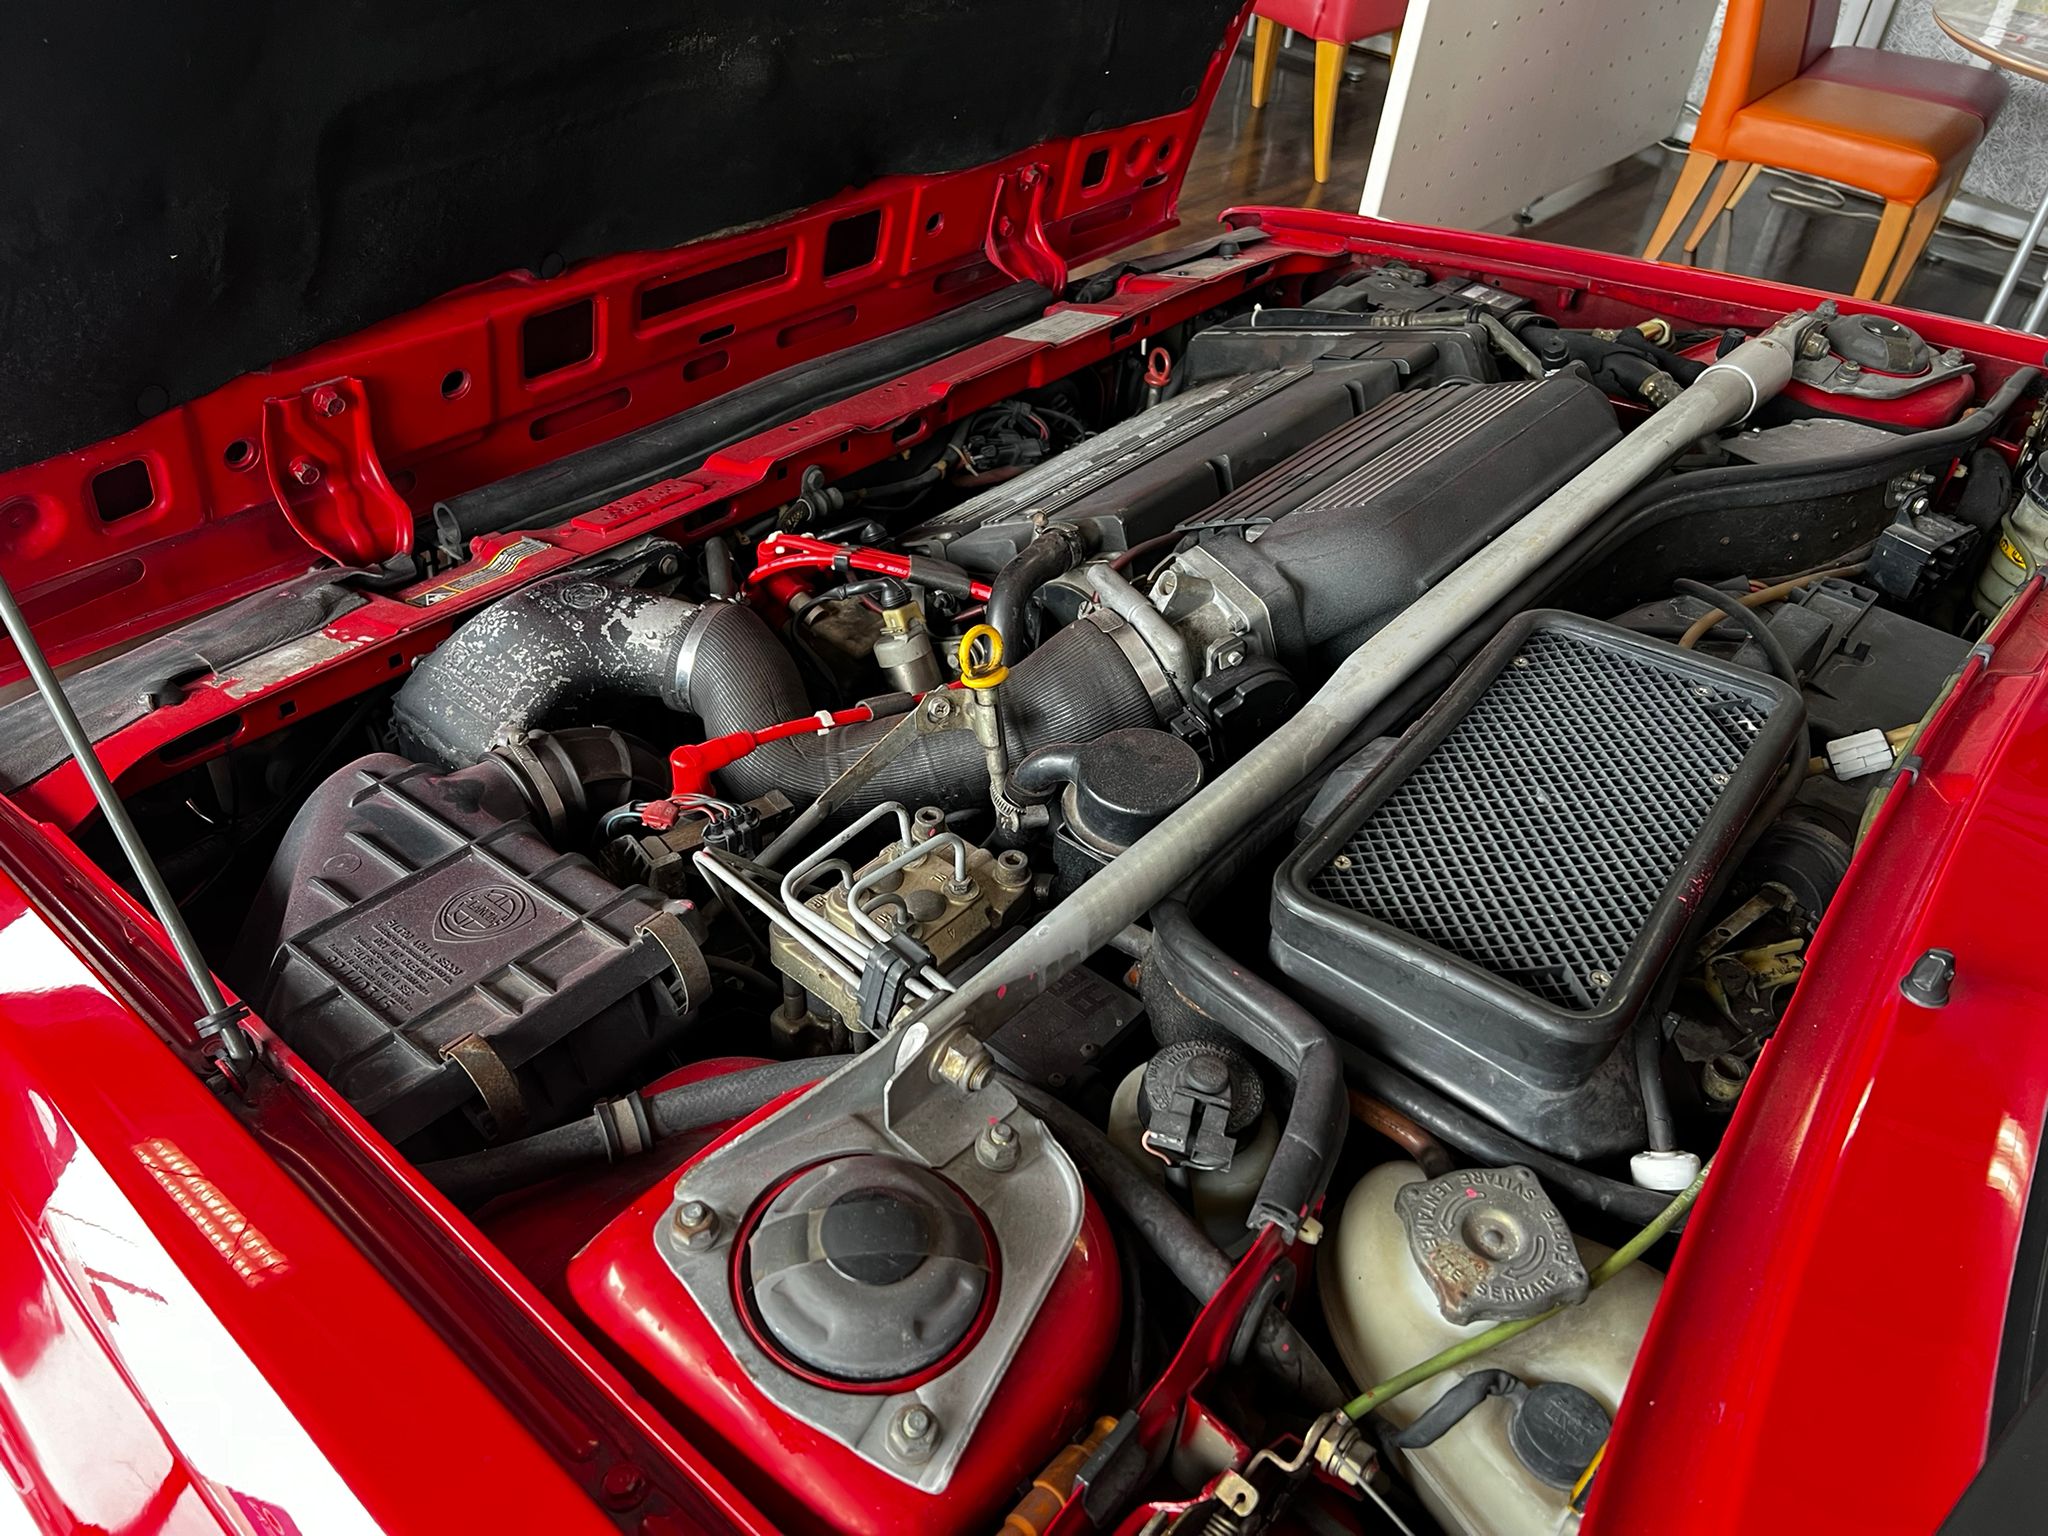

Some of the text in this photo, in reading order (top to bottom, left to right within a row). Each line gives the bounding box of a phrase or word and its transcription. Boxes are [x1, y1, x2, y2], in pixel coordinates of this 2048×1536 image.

[1460, 1171, 1537, 1202] SVITARE
[1475, 1209, 1575, 1302] SERRARE FORTE
